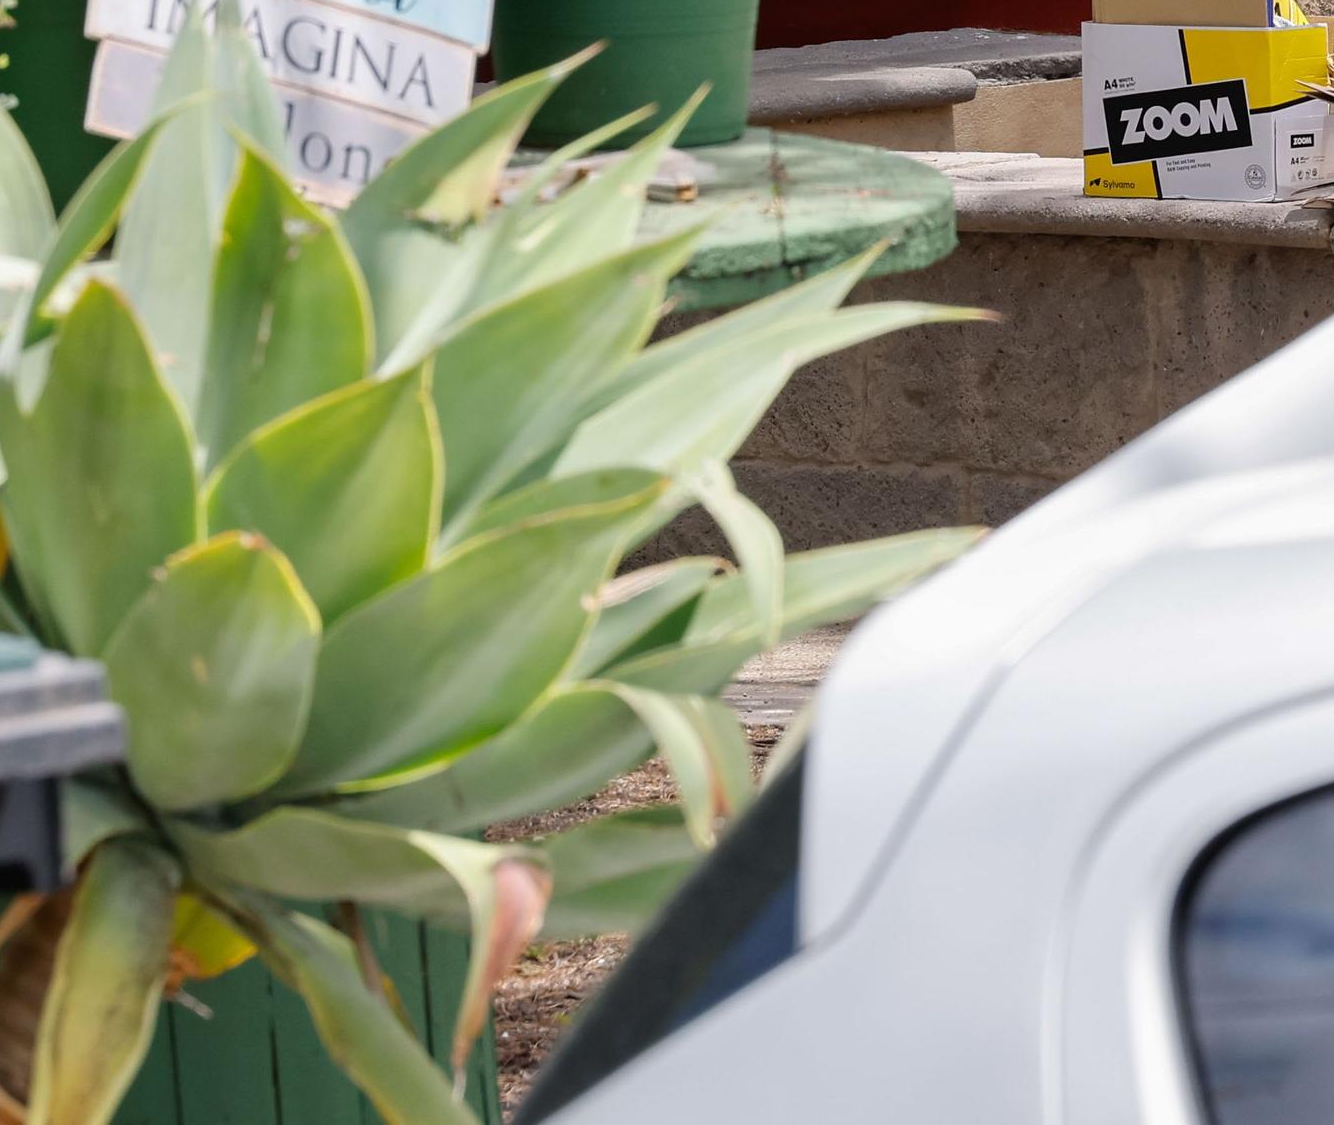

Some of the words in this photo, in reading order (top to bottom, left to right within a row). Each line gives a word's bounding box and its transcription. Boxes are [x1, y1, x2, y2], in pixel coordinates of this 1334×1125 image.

[1104, 78, 1118, 91] A4
[1119, 96, 1239, 146] ZOOM
[1292, 136, 1312, 146] ZOOM
[1290, 157, 1299, 165] A4
[1103, 180, 1135, 190] Sylvamo
